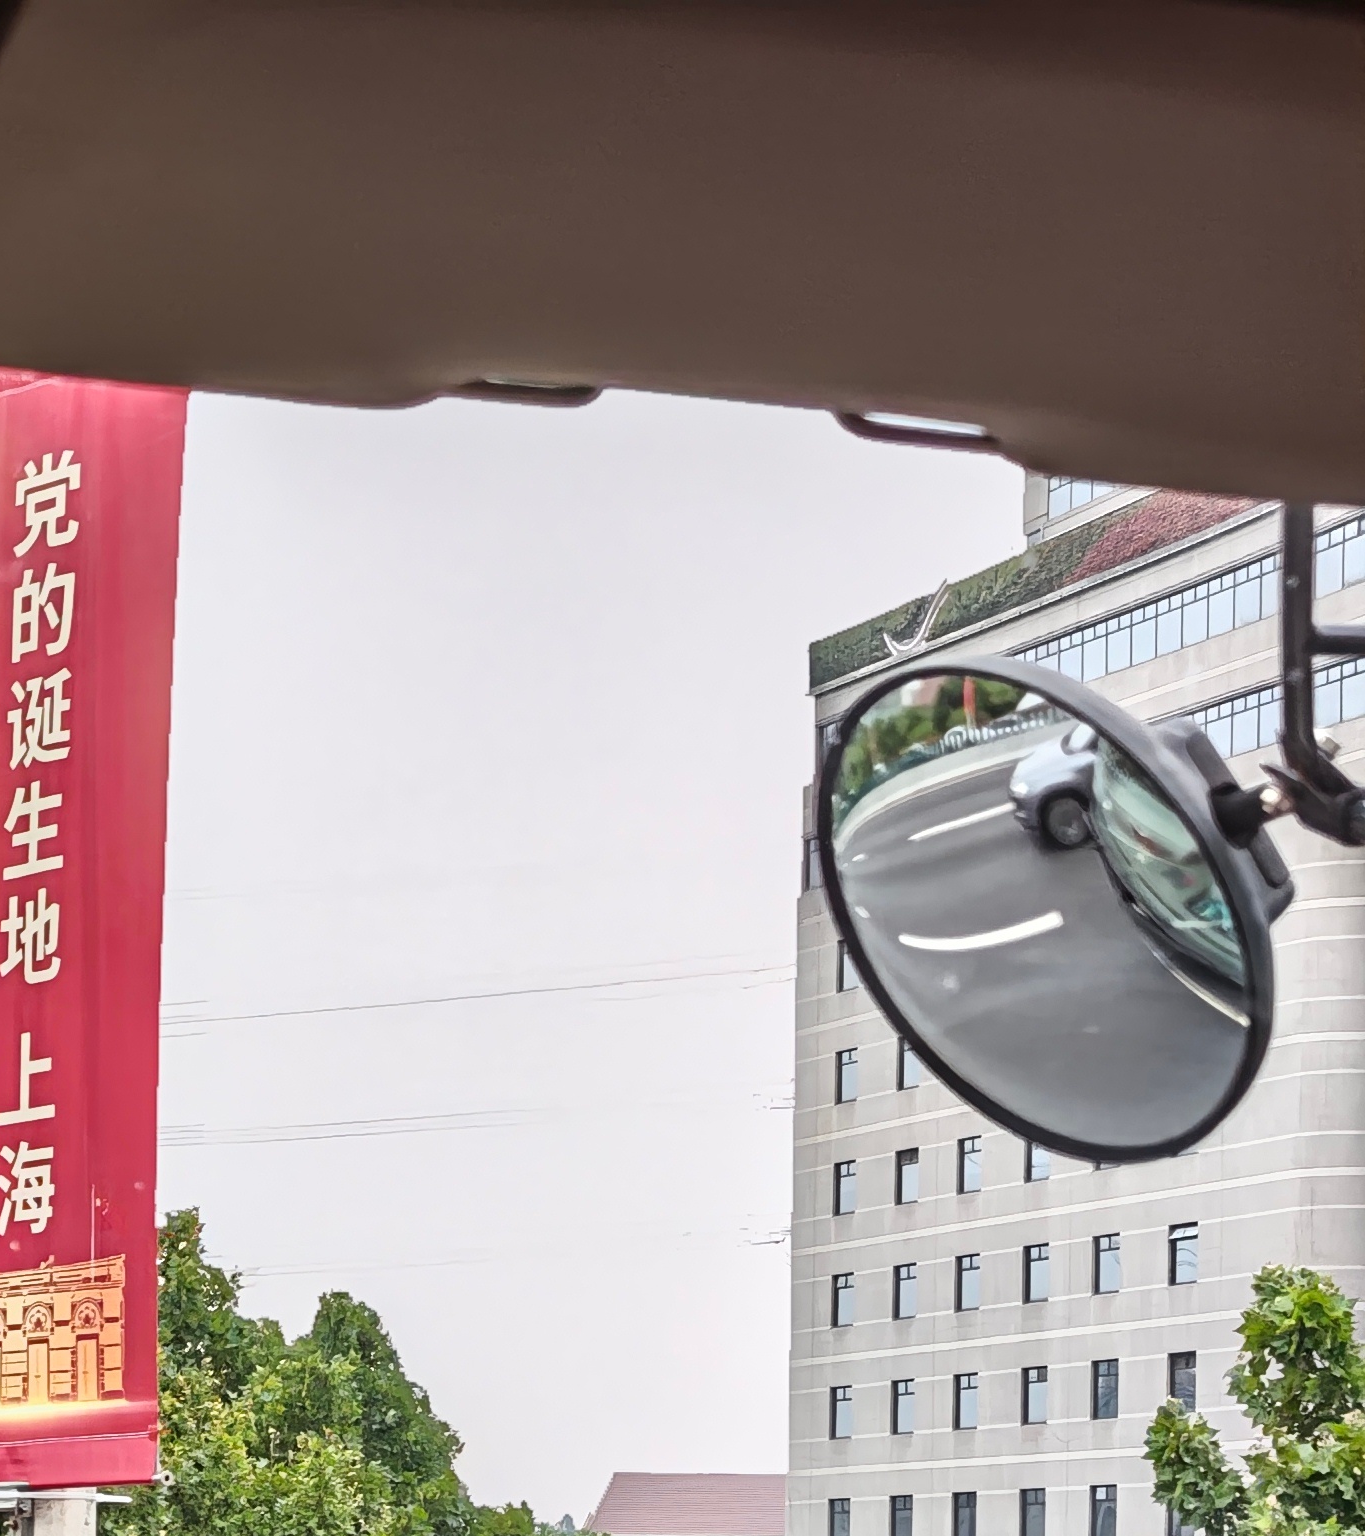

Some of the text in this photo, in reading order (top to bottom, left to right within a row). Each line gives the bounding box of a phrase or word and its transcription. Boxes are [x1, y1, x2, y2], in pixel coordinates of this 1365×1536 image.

[0, 449, 82, 985] 党的诞生地
